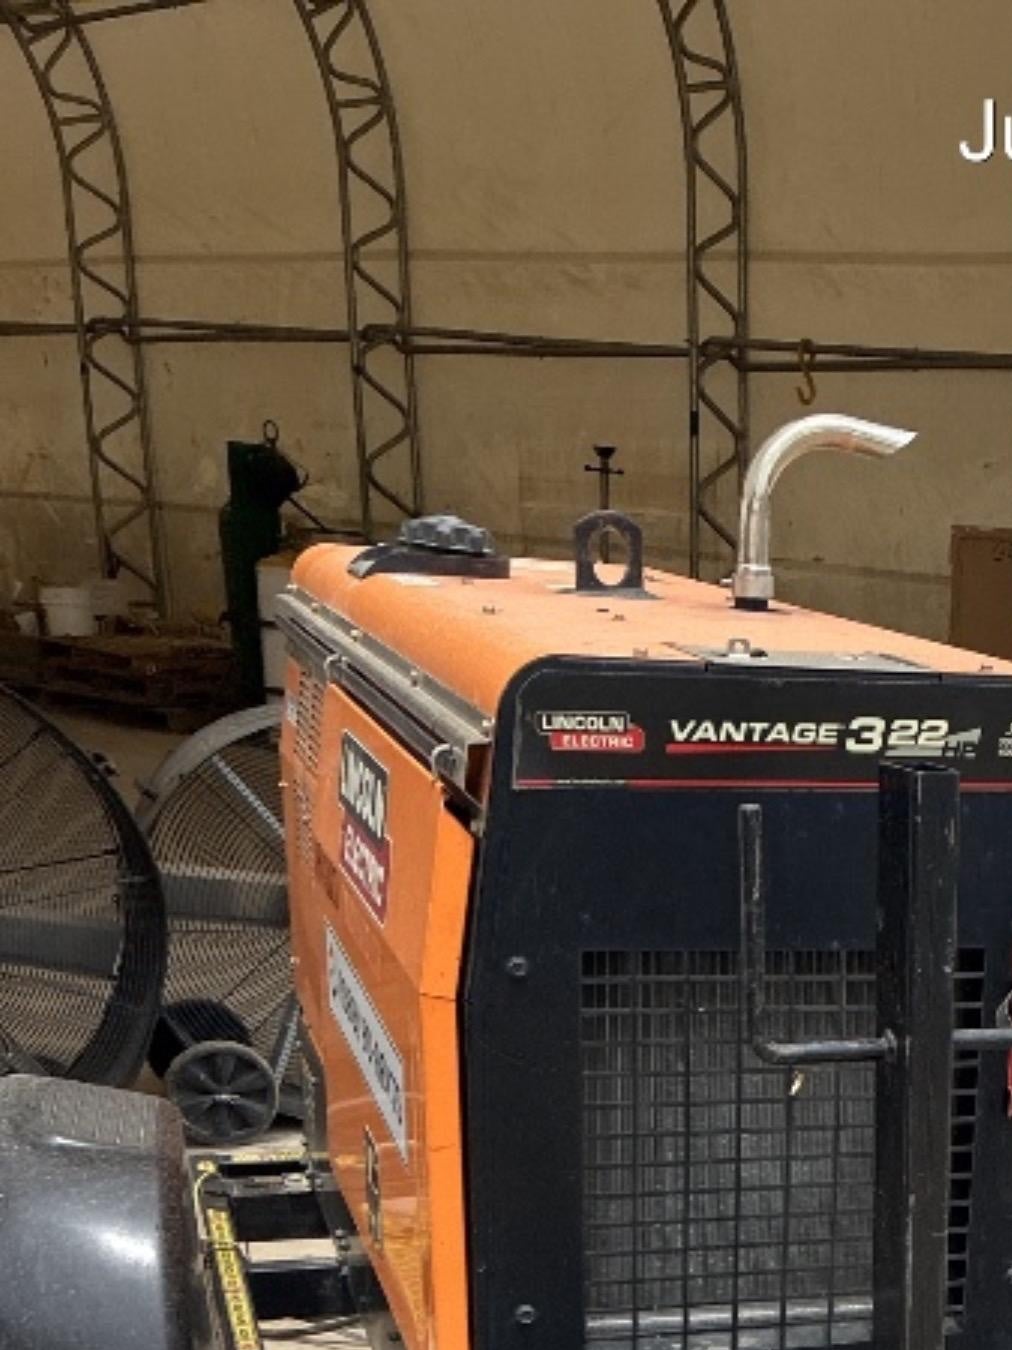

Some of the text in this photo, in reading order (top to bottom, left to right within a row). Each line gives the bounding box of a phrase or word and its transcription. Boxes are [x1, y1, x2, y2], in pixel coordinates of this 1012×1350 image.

[541, 714, 624, 731] LINCOLN
[562, 735, 634, 748] ELECTRIC
[669, 719, 838, 744] VANTAGE
[845, 716, 949, 753] 322
